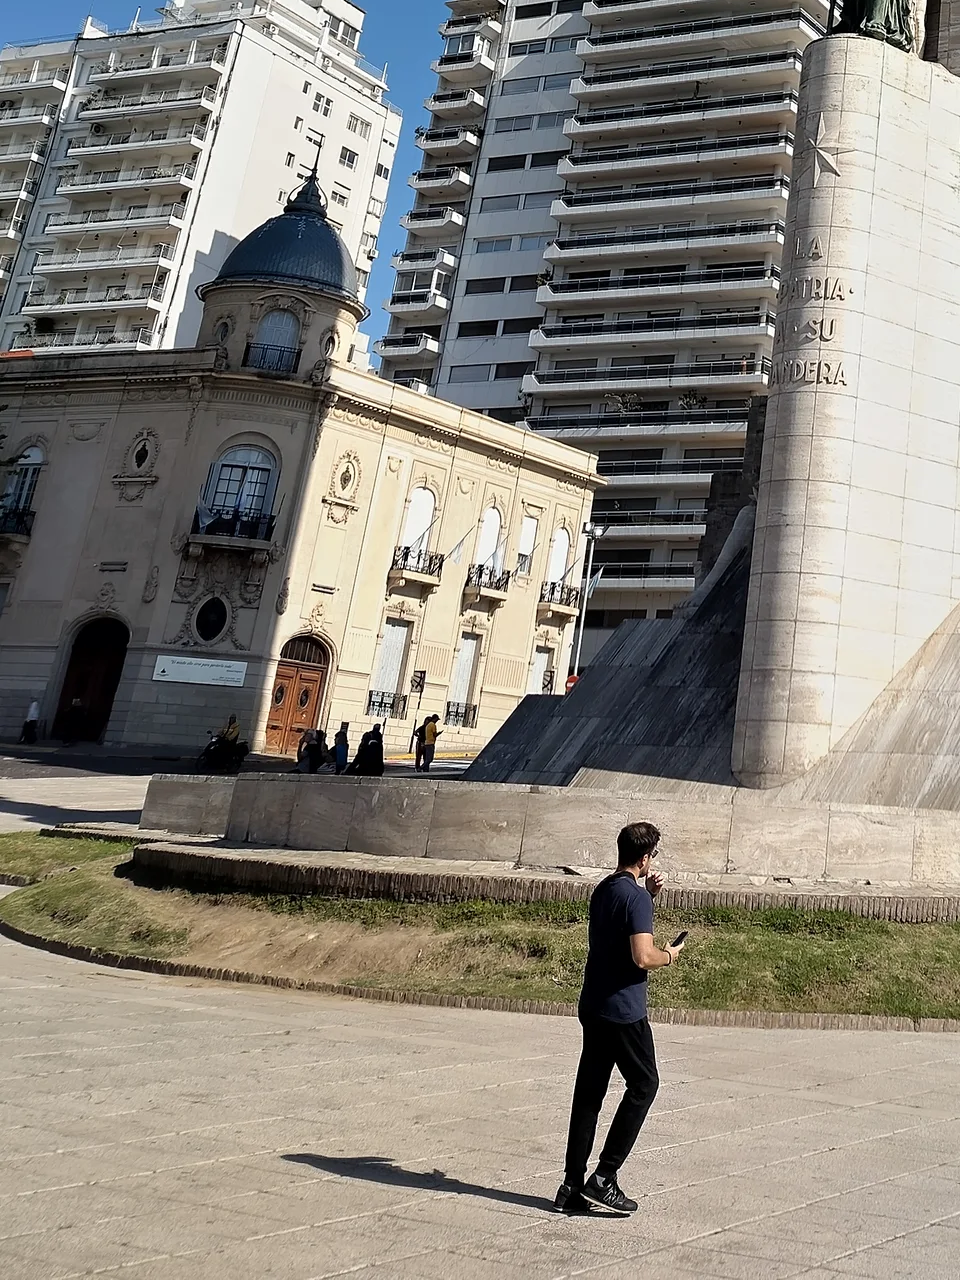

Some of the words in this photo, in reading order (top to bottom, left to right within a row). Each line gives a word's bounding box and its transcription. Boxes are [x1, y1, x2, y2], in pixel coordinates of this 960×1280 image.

[795, 235, 823, 260] LA
[807, 318, 837, 342] SU
[769, 359, 847, 387] ANDERA
